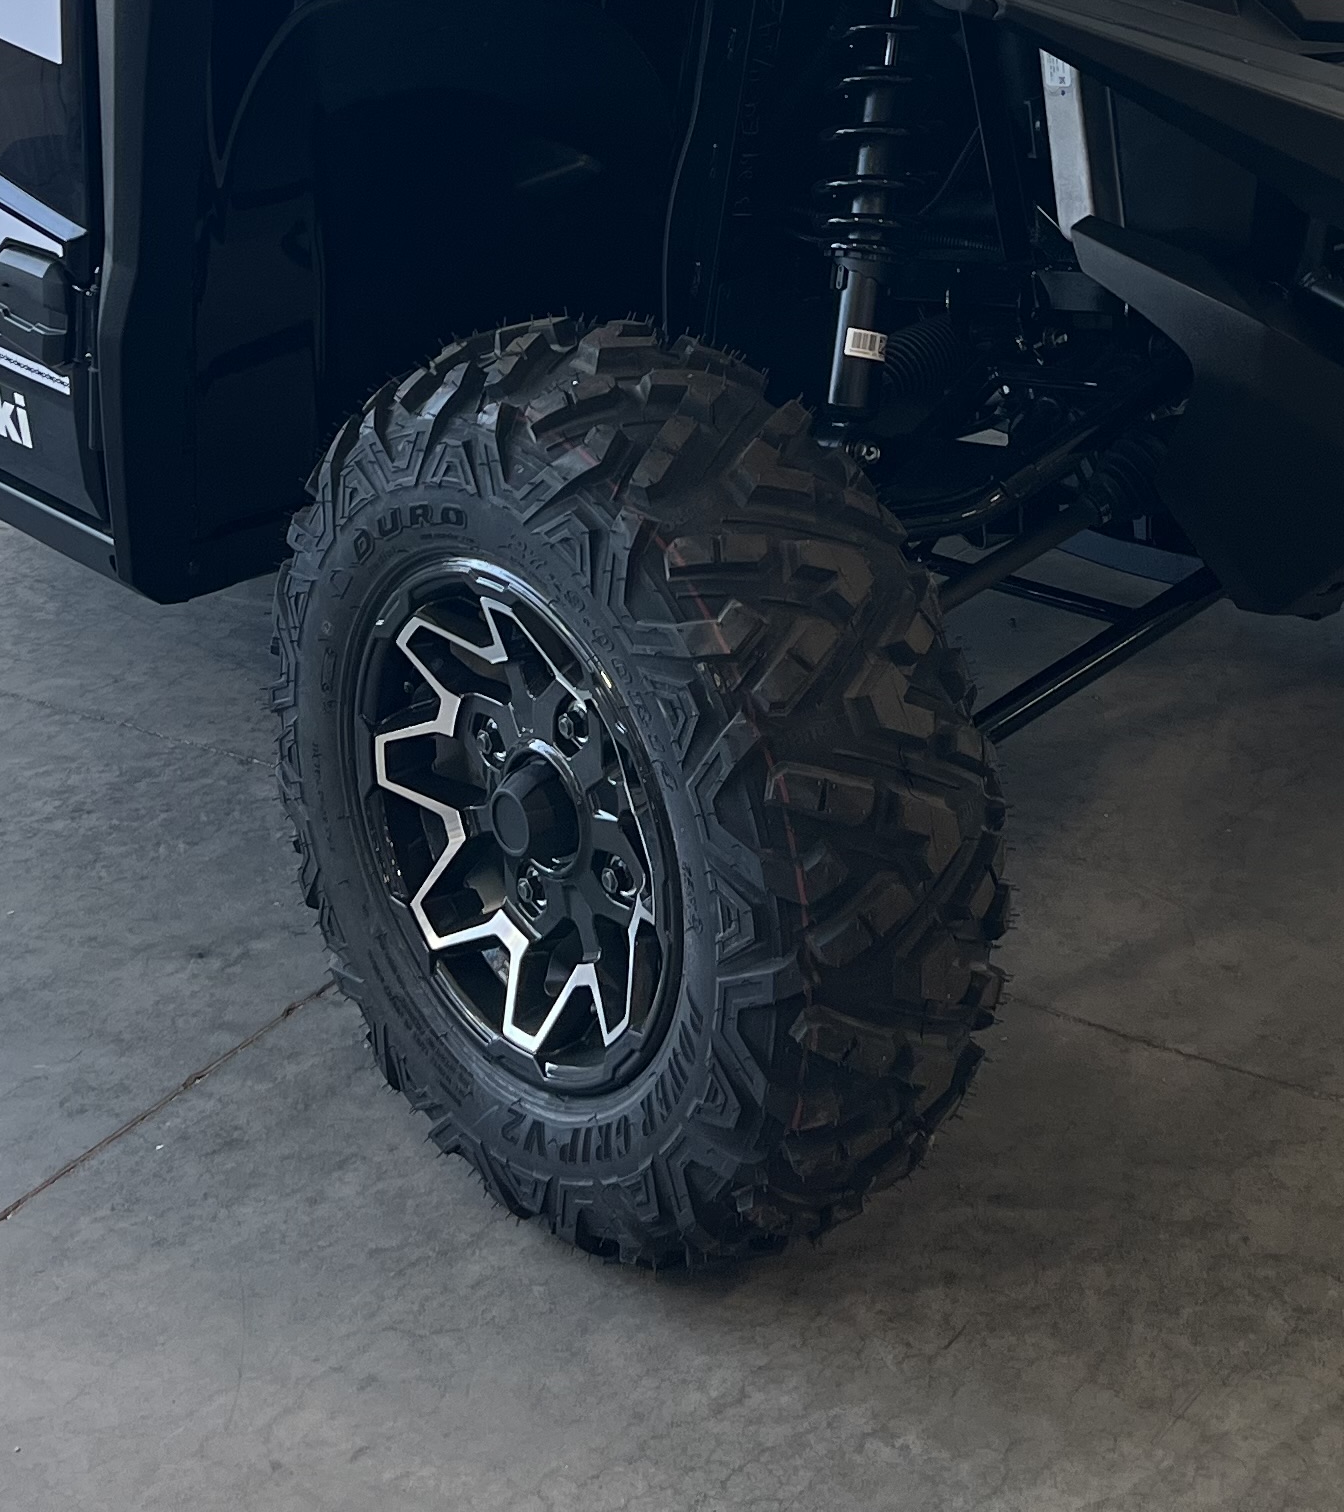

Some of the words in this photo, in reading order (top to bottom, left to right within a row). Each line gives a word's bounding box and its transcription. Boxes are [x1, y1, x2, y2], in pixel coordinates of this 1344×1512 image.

[352, 501, 467, 566] DURO
[640, 986, 704, 1137] POWER
[501, 1107, 548, 1159] V2
[559, 1114, 632, 1166] GRIP
